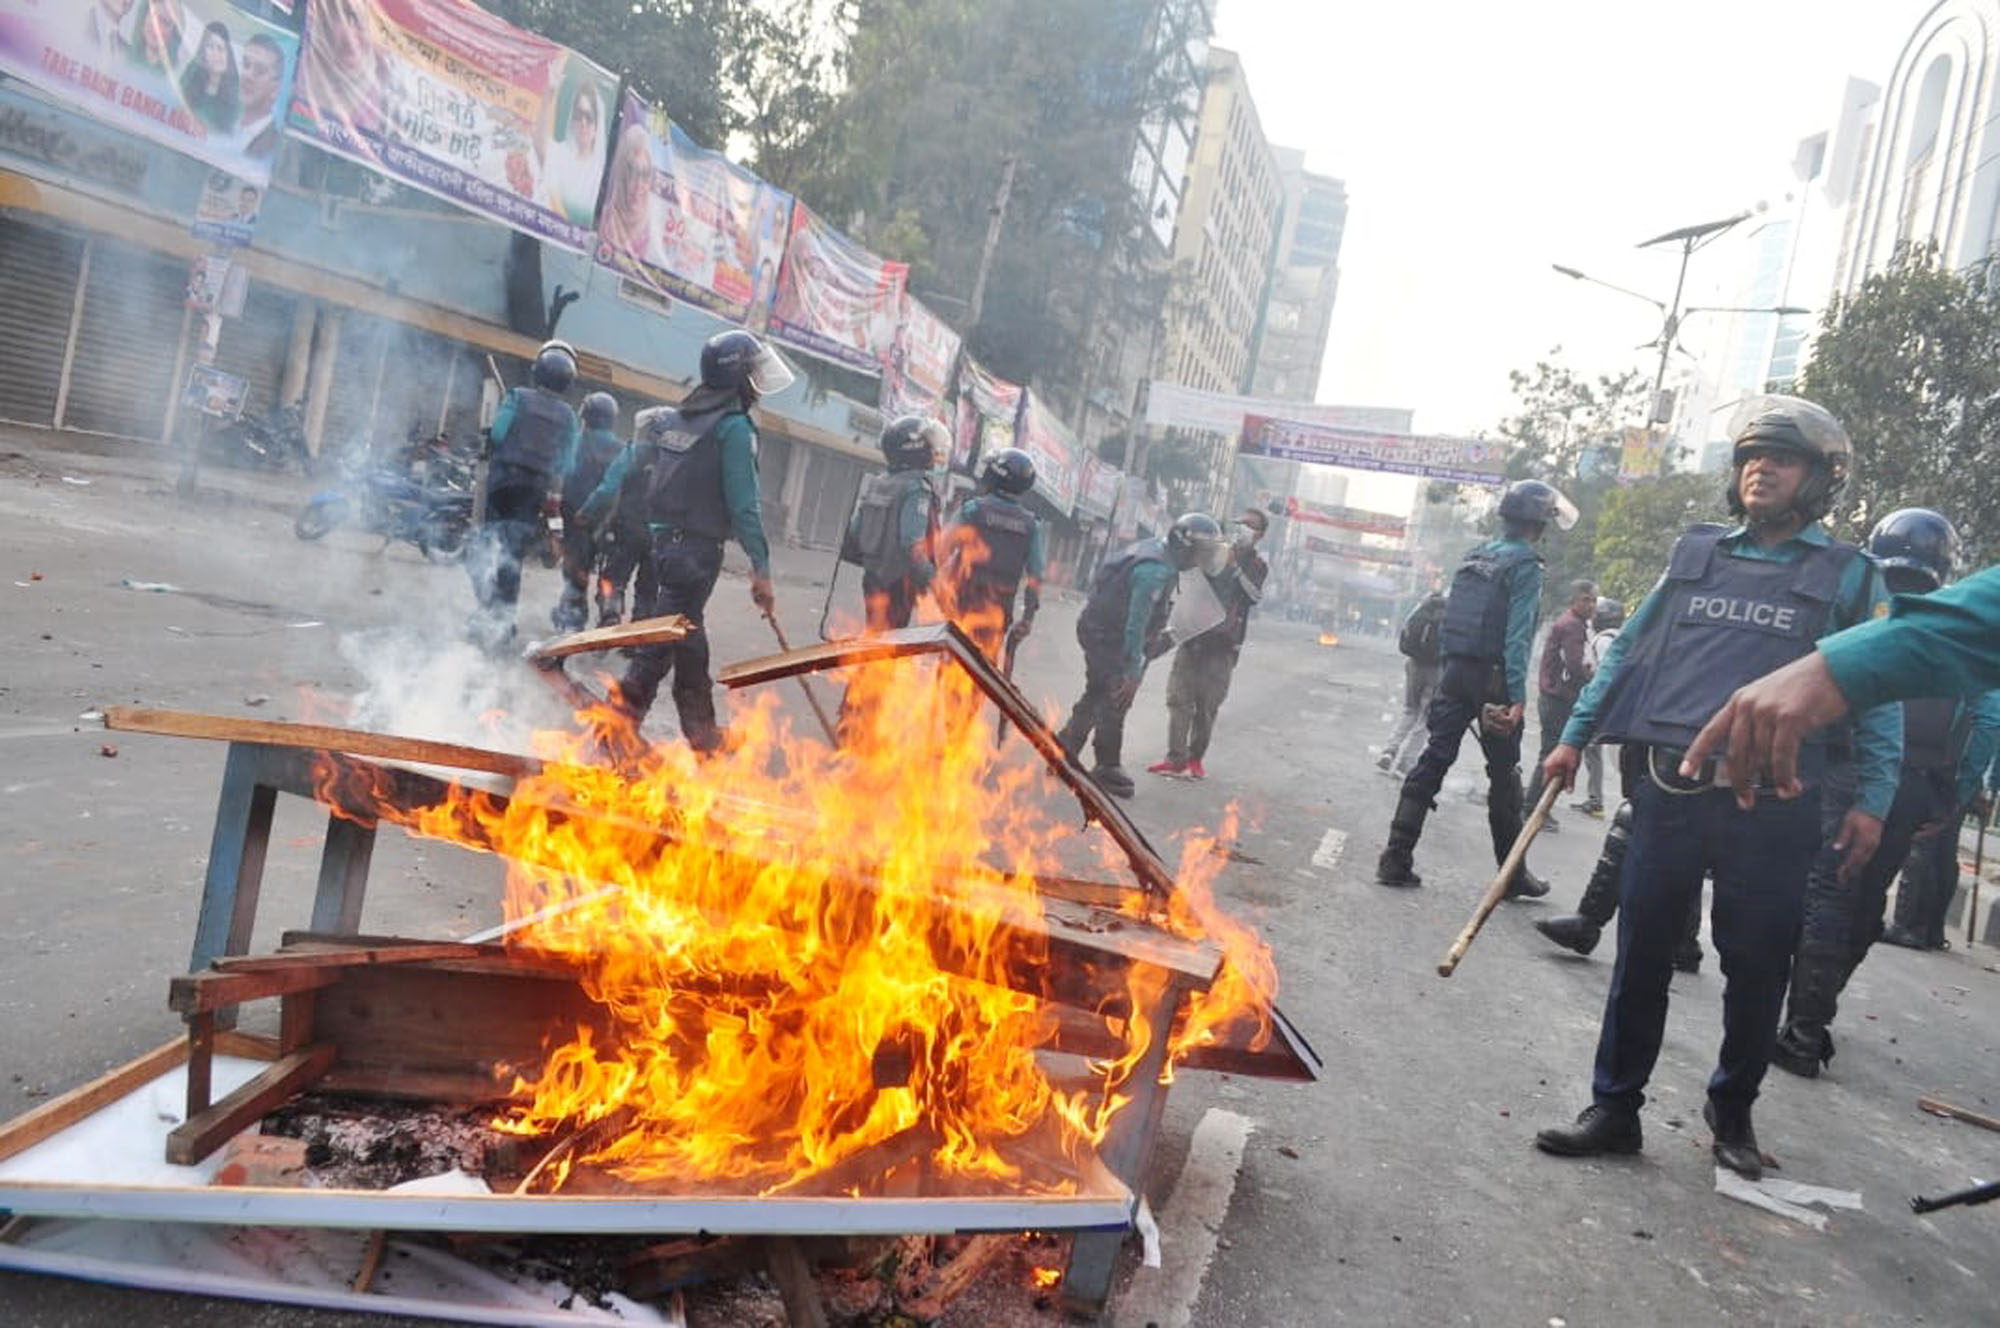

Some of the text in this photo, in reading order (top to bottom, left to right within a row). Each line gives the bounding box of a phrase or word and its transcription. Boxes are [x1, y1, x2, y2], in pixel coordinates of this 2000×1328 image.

[42, 45, 80, 80] TAKE
[80, 64, 119, 101] BACK
[1687, 596, 1796, 630] POLICE
